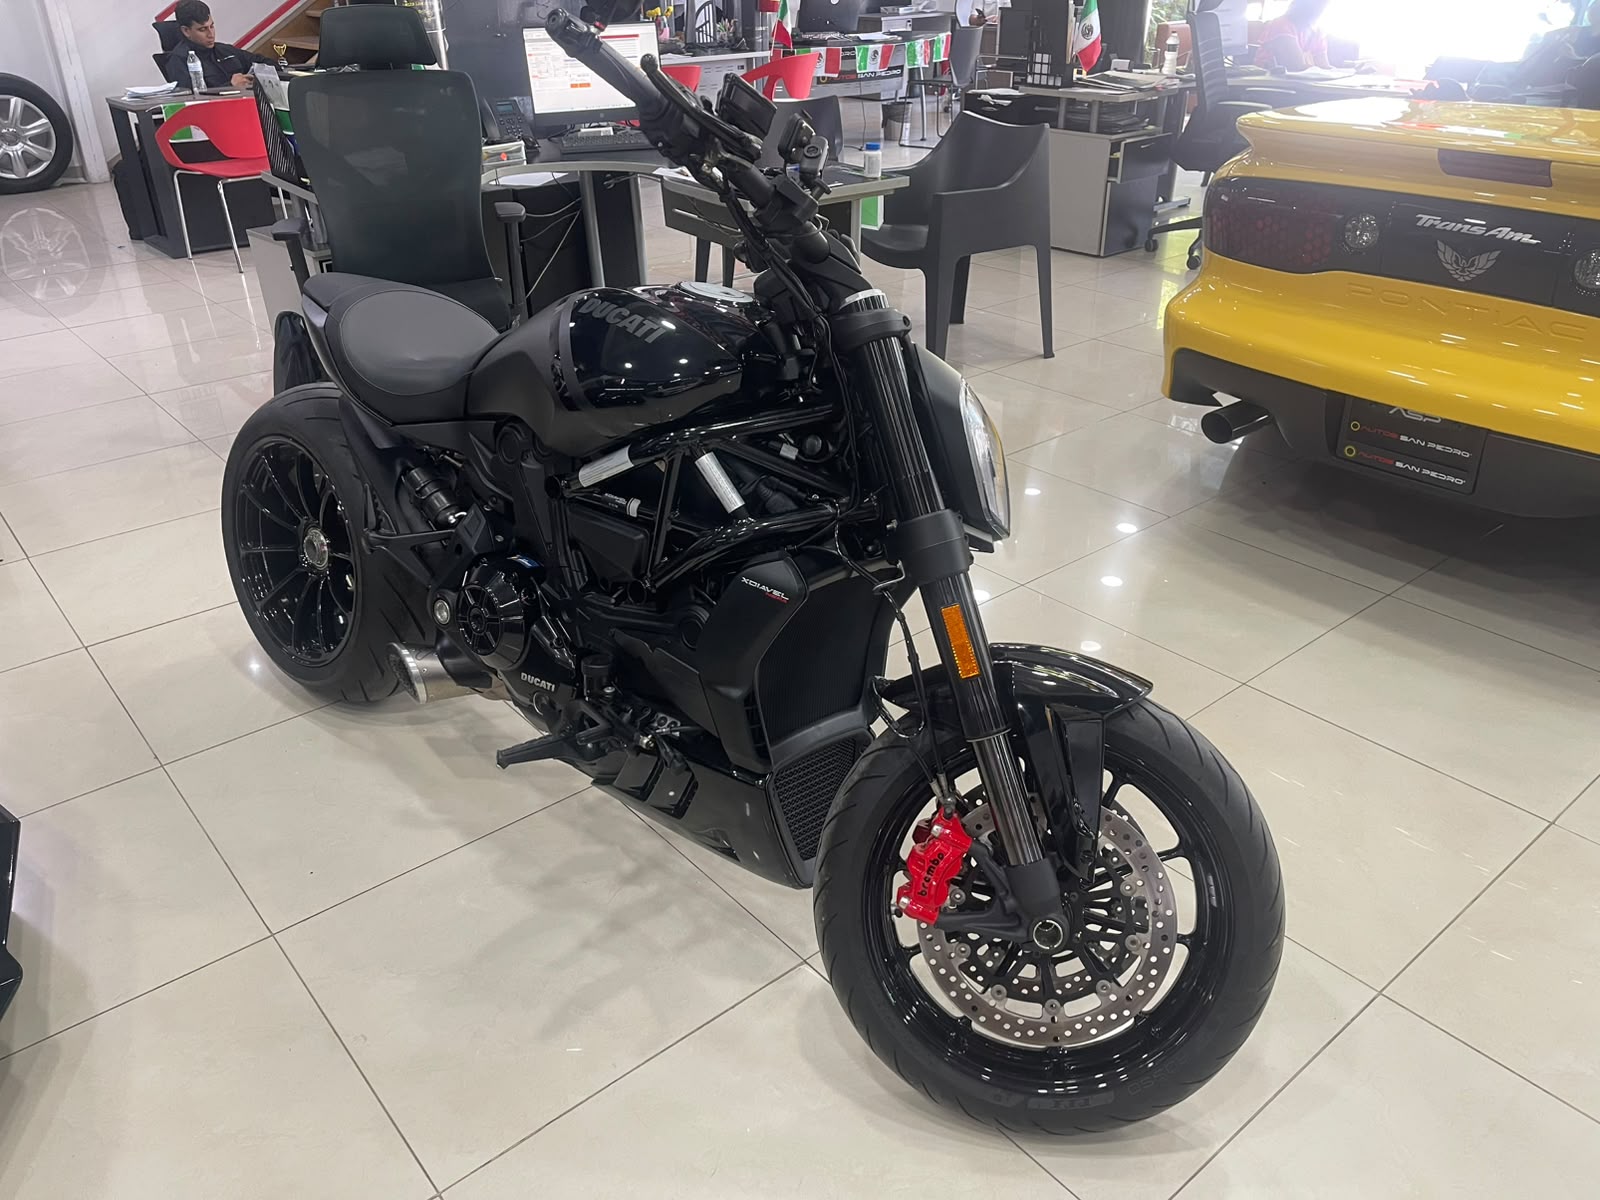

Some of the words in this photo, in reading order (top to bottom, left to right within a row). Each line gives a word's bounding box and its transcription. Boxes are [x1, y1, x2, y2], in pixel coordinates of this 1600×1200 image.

[1416, 213, 1488, 236] Trans
[1486, 226, 1542, 245] Am
[578, 298, 667, 344] DUCATI
[1346, 282, 1588, 342] PONTIAC
[1360, 425, 1400, 439] AUTOS
[1400, 434, 1426, 447] SAN
[1427, 441, 1471, 458] PEDRO
[1395, 461, 1421, 473] SAN
[1421, 469, 1466, 485] PEDRO
[741, 576, 790, 601] XDIAVEL
[520, 672, 556, 692] DUCATI
[917, 852, 945, 897] brembo
